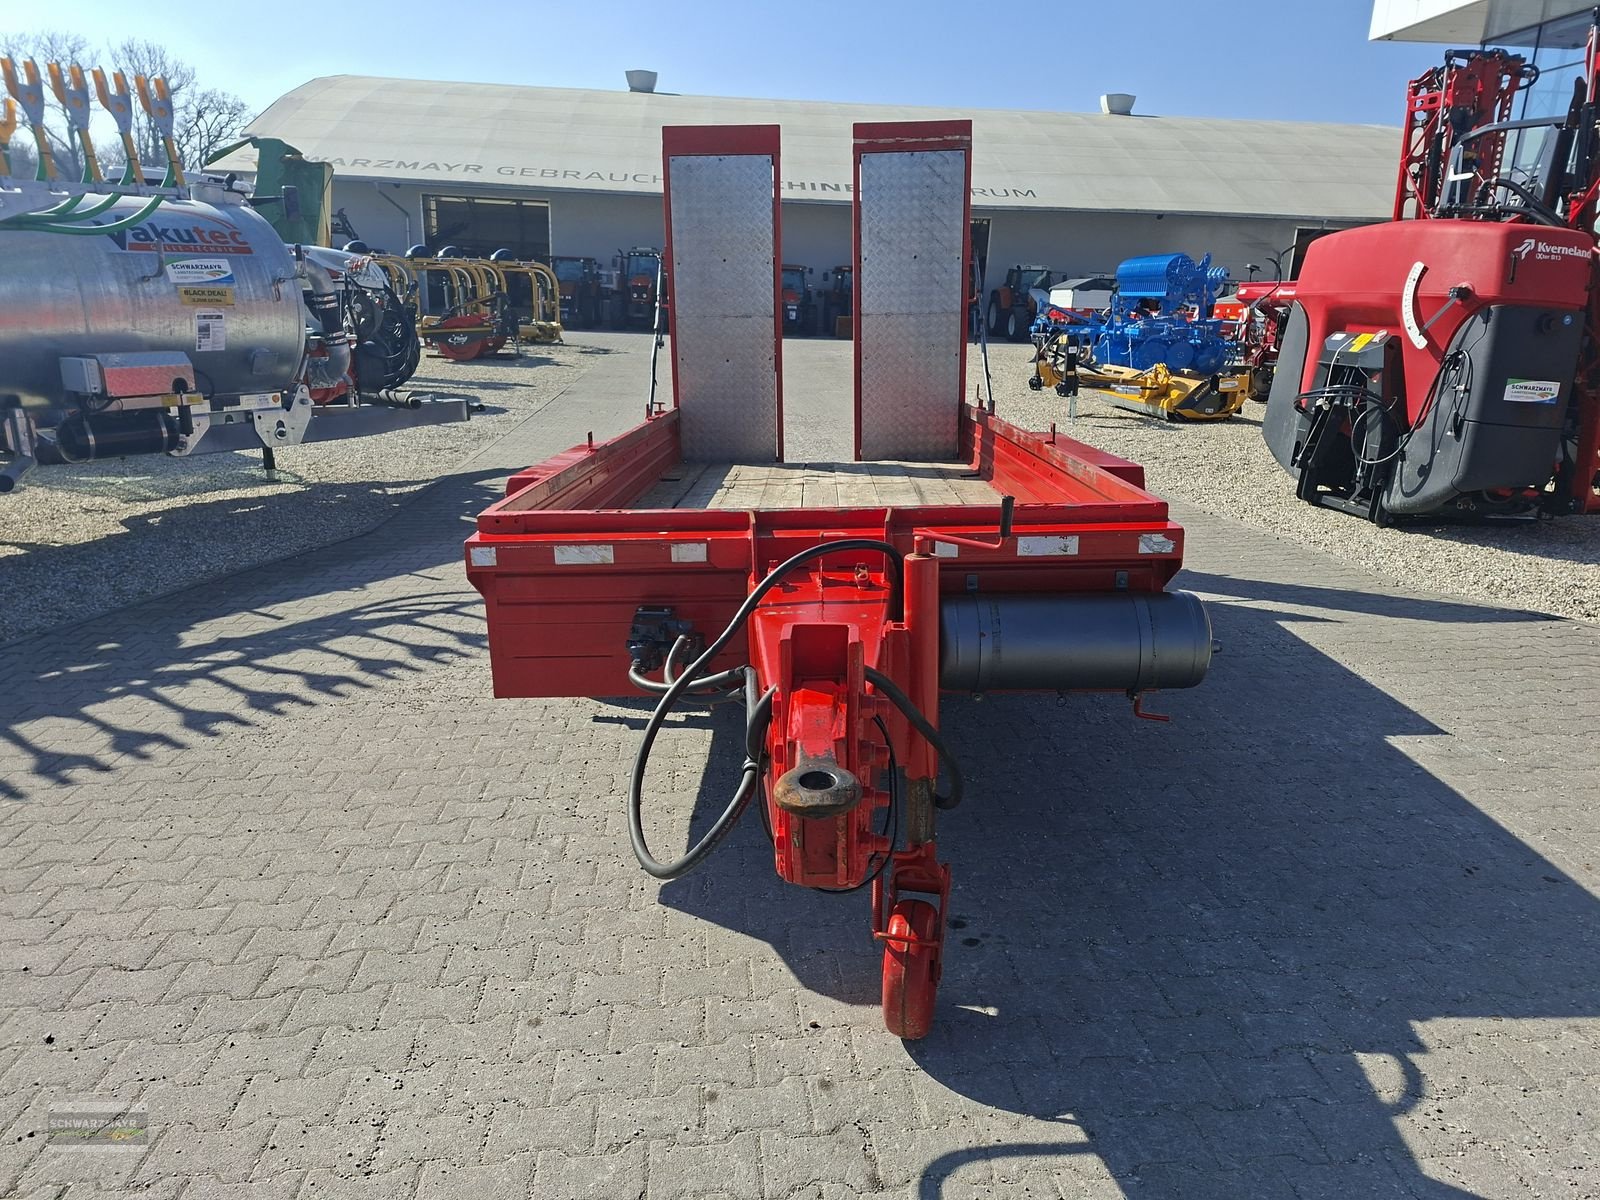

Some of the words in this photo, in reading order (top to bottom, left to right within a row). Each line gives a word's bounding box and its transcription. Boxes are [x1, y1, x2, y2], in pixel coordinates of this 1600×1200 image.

[150, 244, 235, 253] GLLE-TECHNIK
[1537, 241, 1592, 259] Kverneland
[1511, 384, 1553, 392] SCHWARZMAYR
